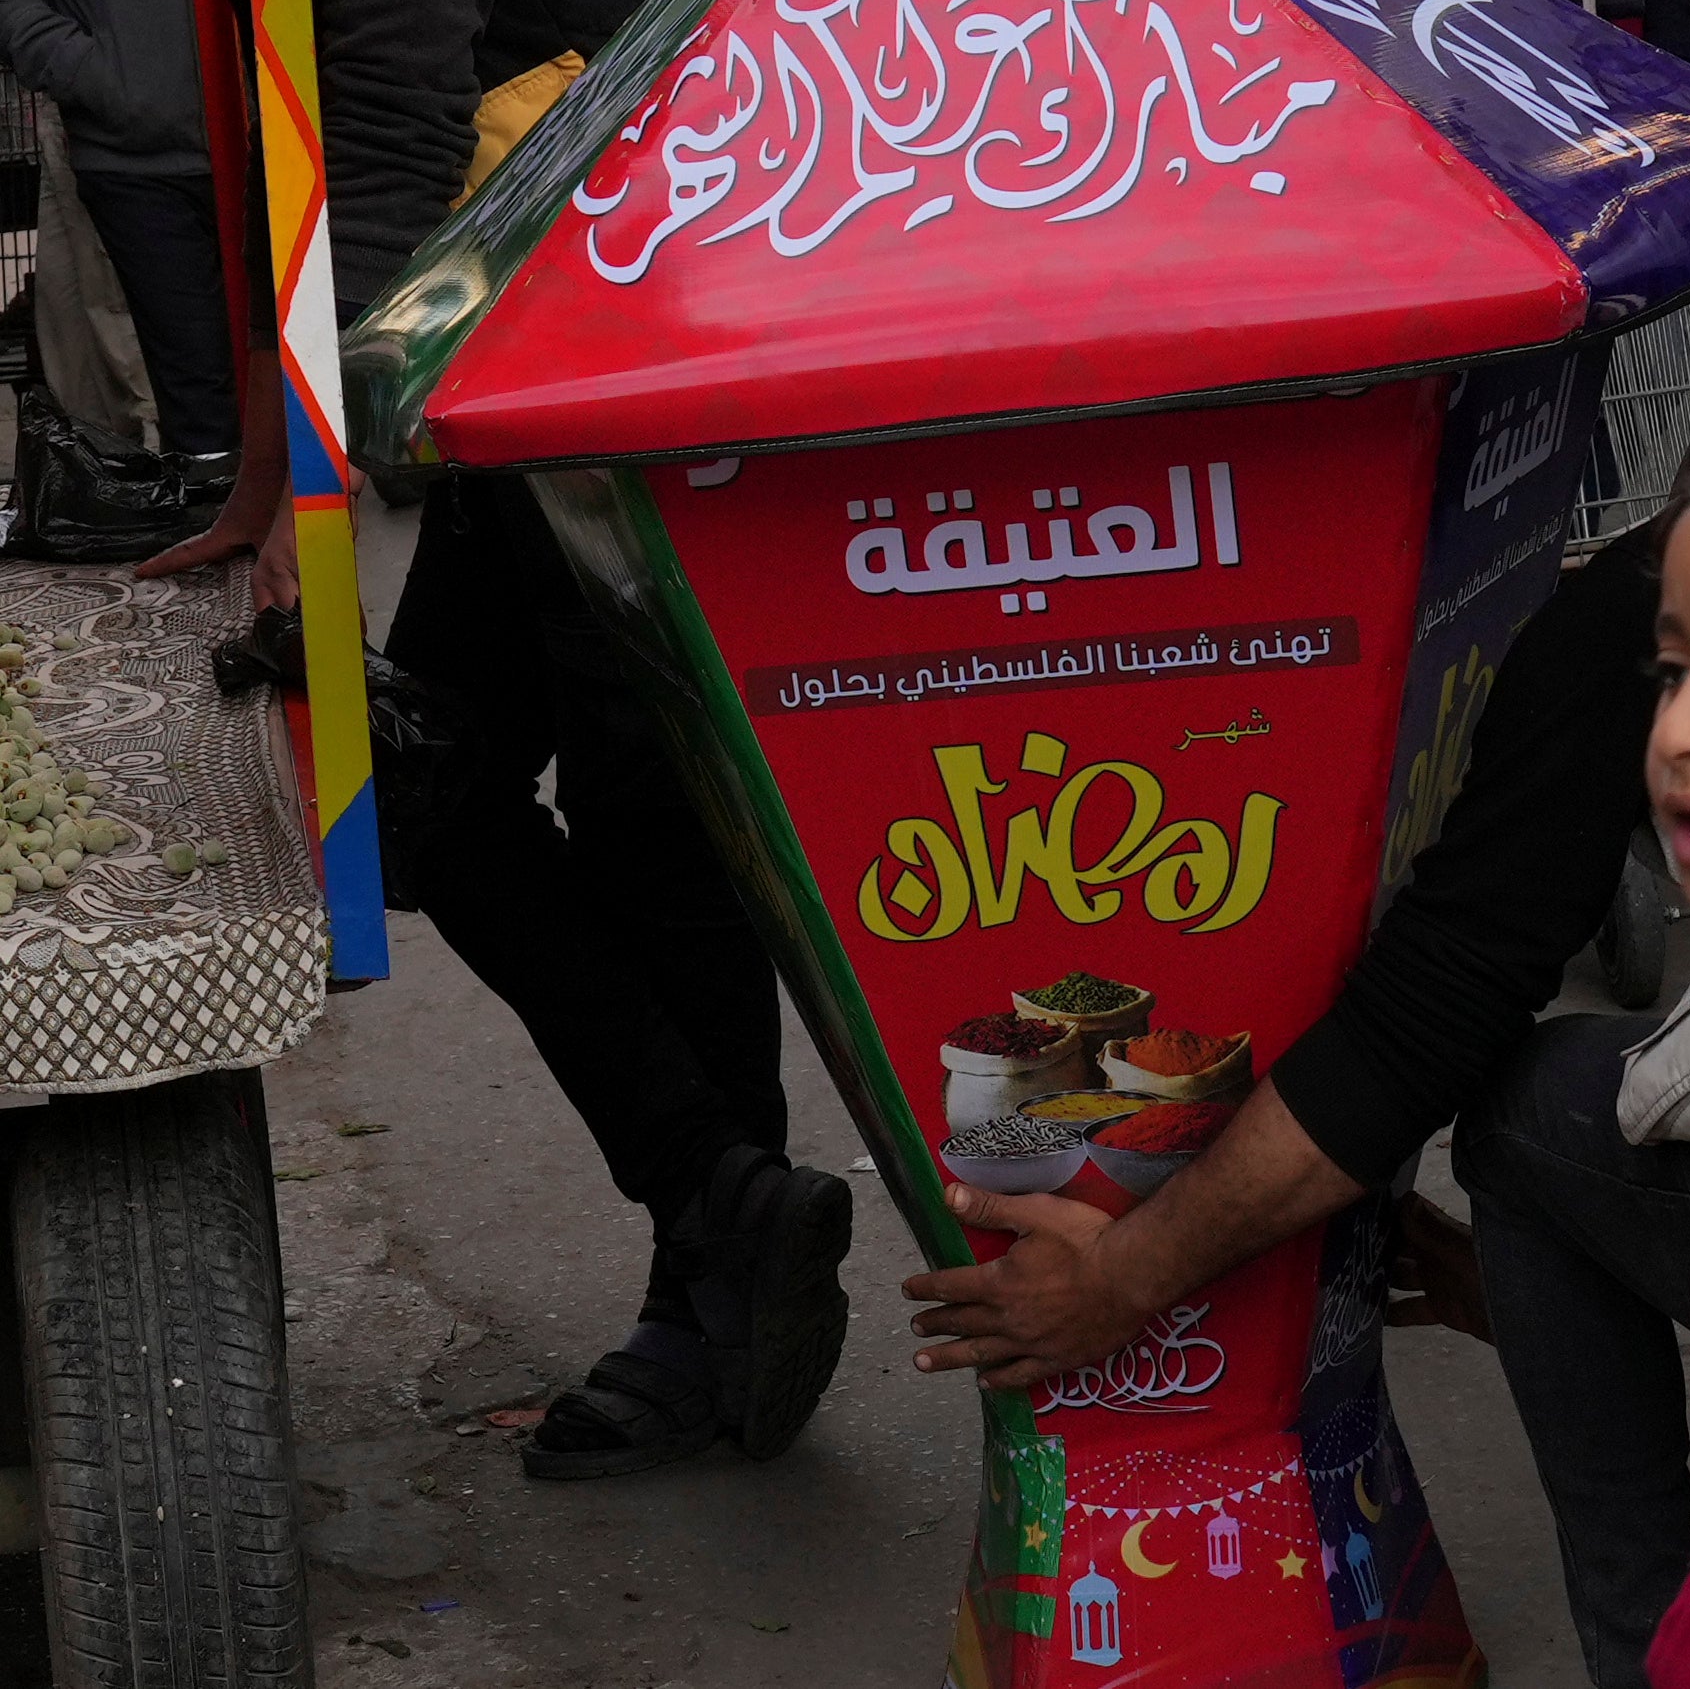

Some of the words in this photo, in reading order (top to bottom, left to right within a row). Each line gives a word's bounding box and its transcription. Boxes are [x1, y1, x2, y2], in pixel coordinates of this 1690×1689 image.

[845, 461, 1241, 615] العتيقة
[896, 642, 1107, 701] الفلسطيني
[1114, 630, 1219, 680] شعبنا
[1229, 626, 1333, 667] تهنئ
[778, 666, 888, 710] بحلول
[1172, 706, 1272, 752] شهر
[856, 730, 1289, 942] رمضان
